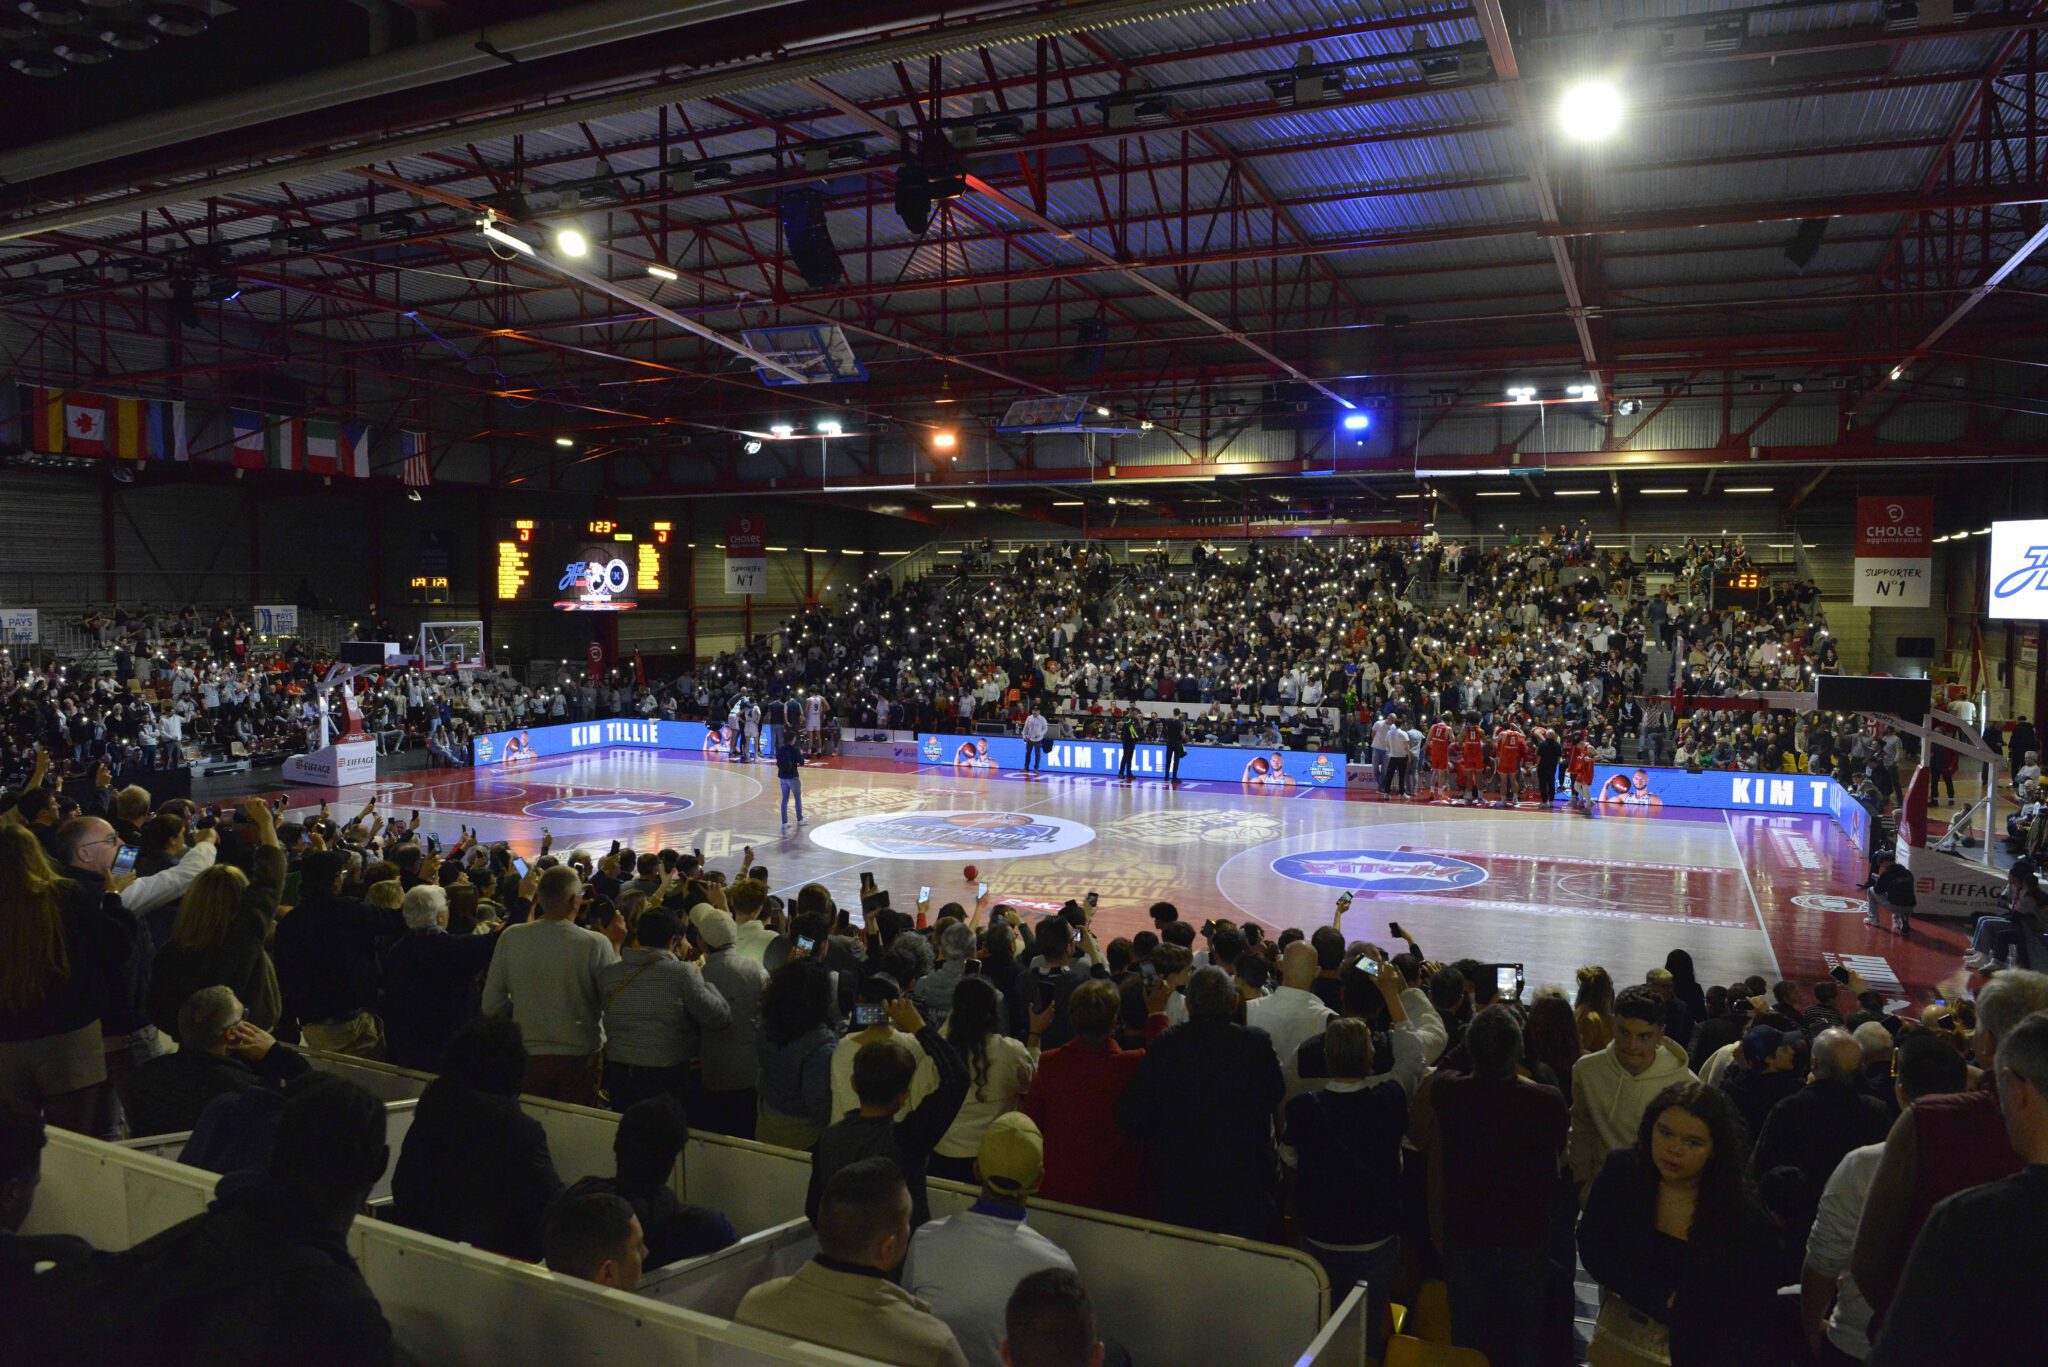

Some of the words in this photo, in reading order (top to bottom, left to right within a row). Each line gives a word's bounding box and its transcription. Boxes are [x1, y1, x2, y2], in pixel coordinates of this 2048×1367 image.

[1865, 568, 1922, 578] SUPPORTER
[1876, 579, 1906, 597] N°1
[8, 617, 33, 627] PAYS
[571, 723, 601, 747] KIM
[607, 722, 659, 744] TILLIE
[347, 756, 375, 767] EIFFAGE
[1048, 744, 1092, 770] KIM
[1102, 747, 1175, 773] TILLI
[303, 761, 331, 774] EIFFAGE
[1732, 777, 1794, 806] KIM
[953, 829, 1057, 842] MONDIAL
[1489, 852, 1549, 863] JEUNE
[1553, 856, 1637, 868] FRANCE
[1643, 862, 1725, 874] CHOLET
[981, 875, 1073, 885] CHOLET
[1080, 877, 1191, 889] MONDIAL
[987, 881, 1165, 898] BASKETBALL
[1940, 882, 2002, 899] EIFFAG
[1546, 905, 1642, 922] FRANCE
[1650, 913, 1748, 929] CHOLET
